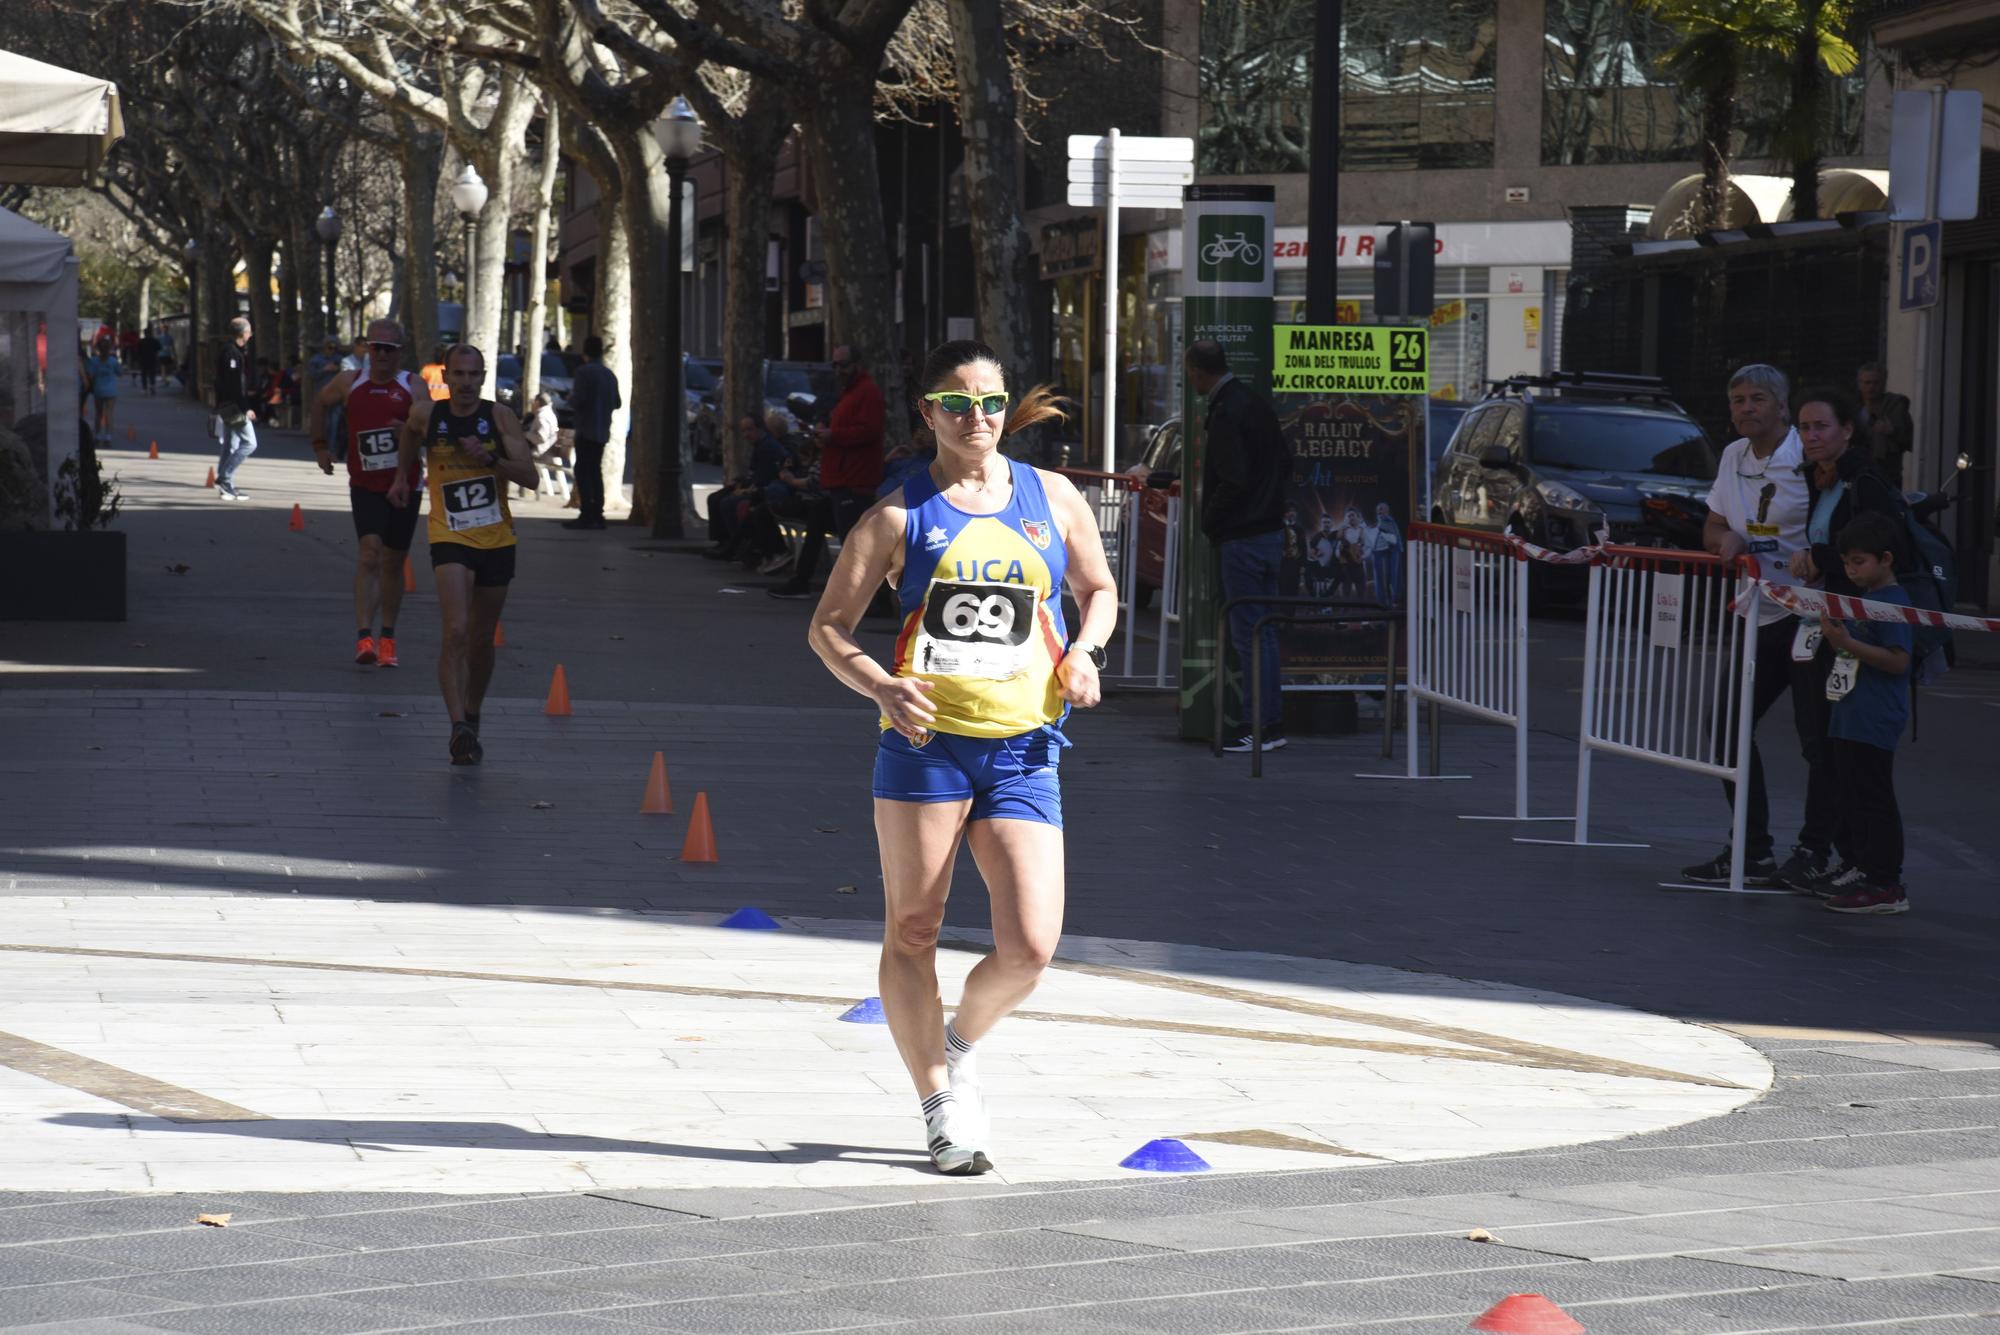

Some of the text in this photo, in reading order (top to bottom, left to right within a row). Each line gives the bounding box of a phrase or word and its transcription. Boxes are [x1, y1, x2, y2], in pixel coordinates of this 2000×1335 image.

[1907, 233, 1932, 300] P
[1290, 331, 1374, 351] MANRESA
[1394, 334, 1421, 360] 26
[1285, 355, 1381, 369] ZONA DELS TRULLOLS
[1272, 374, 1425, 391] W.CIRCORALUY.COM
[1304, 422, 1363, 438] RALUY
[366, 433, 394, 454] 15
[1295, 439, 1374, 458] LEGACY
[454, 483, 489, 509] 12
[956, 560, 1025, 583] UCA
[942, 593, 1016, 638] 69
